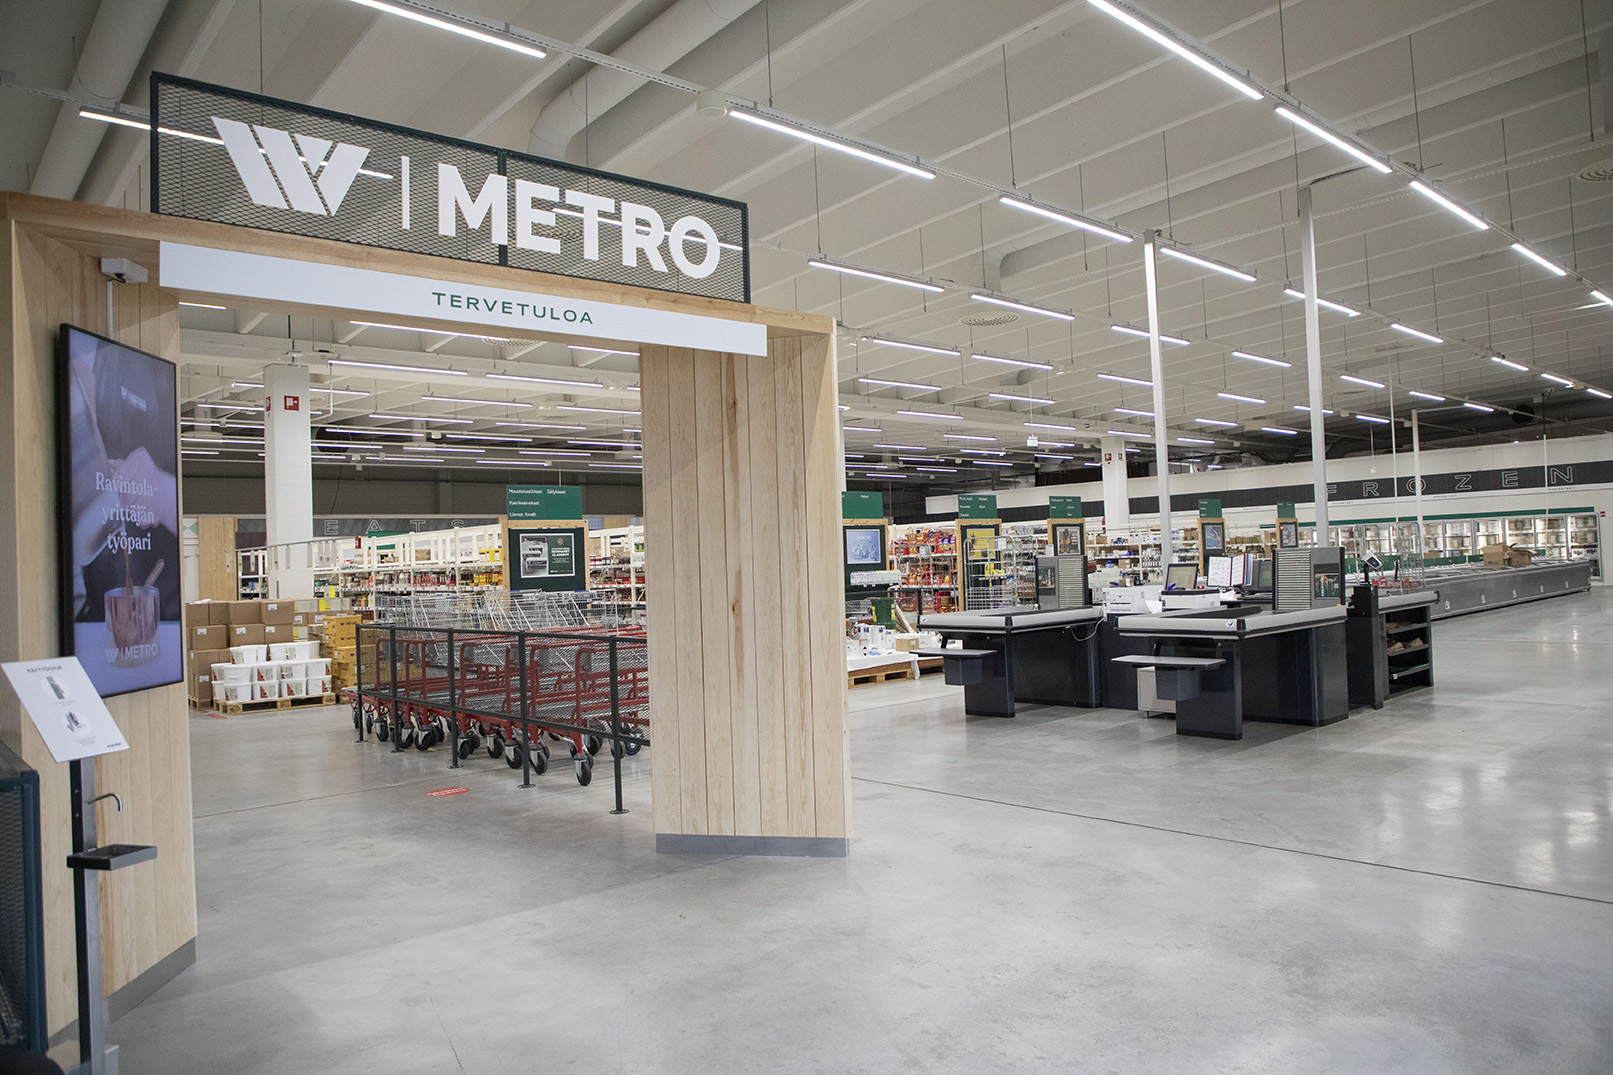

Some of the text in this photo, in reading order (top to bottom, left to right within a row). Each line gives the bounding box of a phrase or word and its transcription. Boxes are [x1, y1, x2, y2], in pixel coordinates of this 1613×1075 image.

[438, 163, 721, 279] METRO
[432, 291, 593, 325] TERVETULOA
[95, 471, 158, 497] Ravintola-
[101, 502, 155, 529] yrittäjän
[107, 531, 152, 553] työpari
[126, 643, 158, 662] METRO
